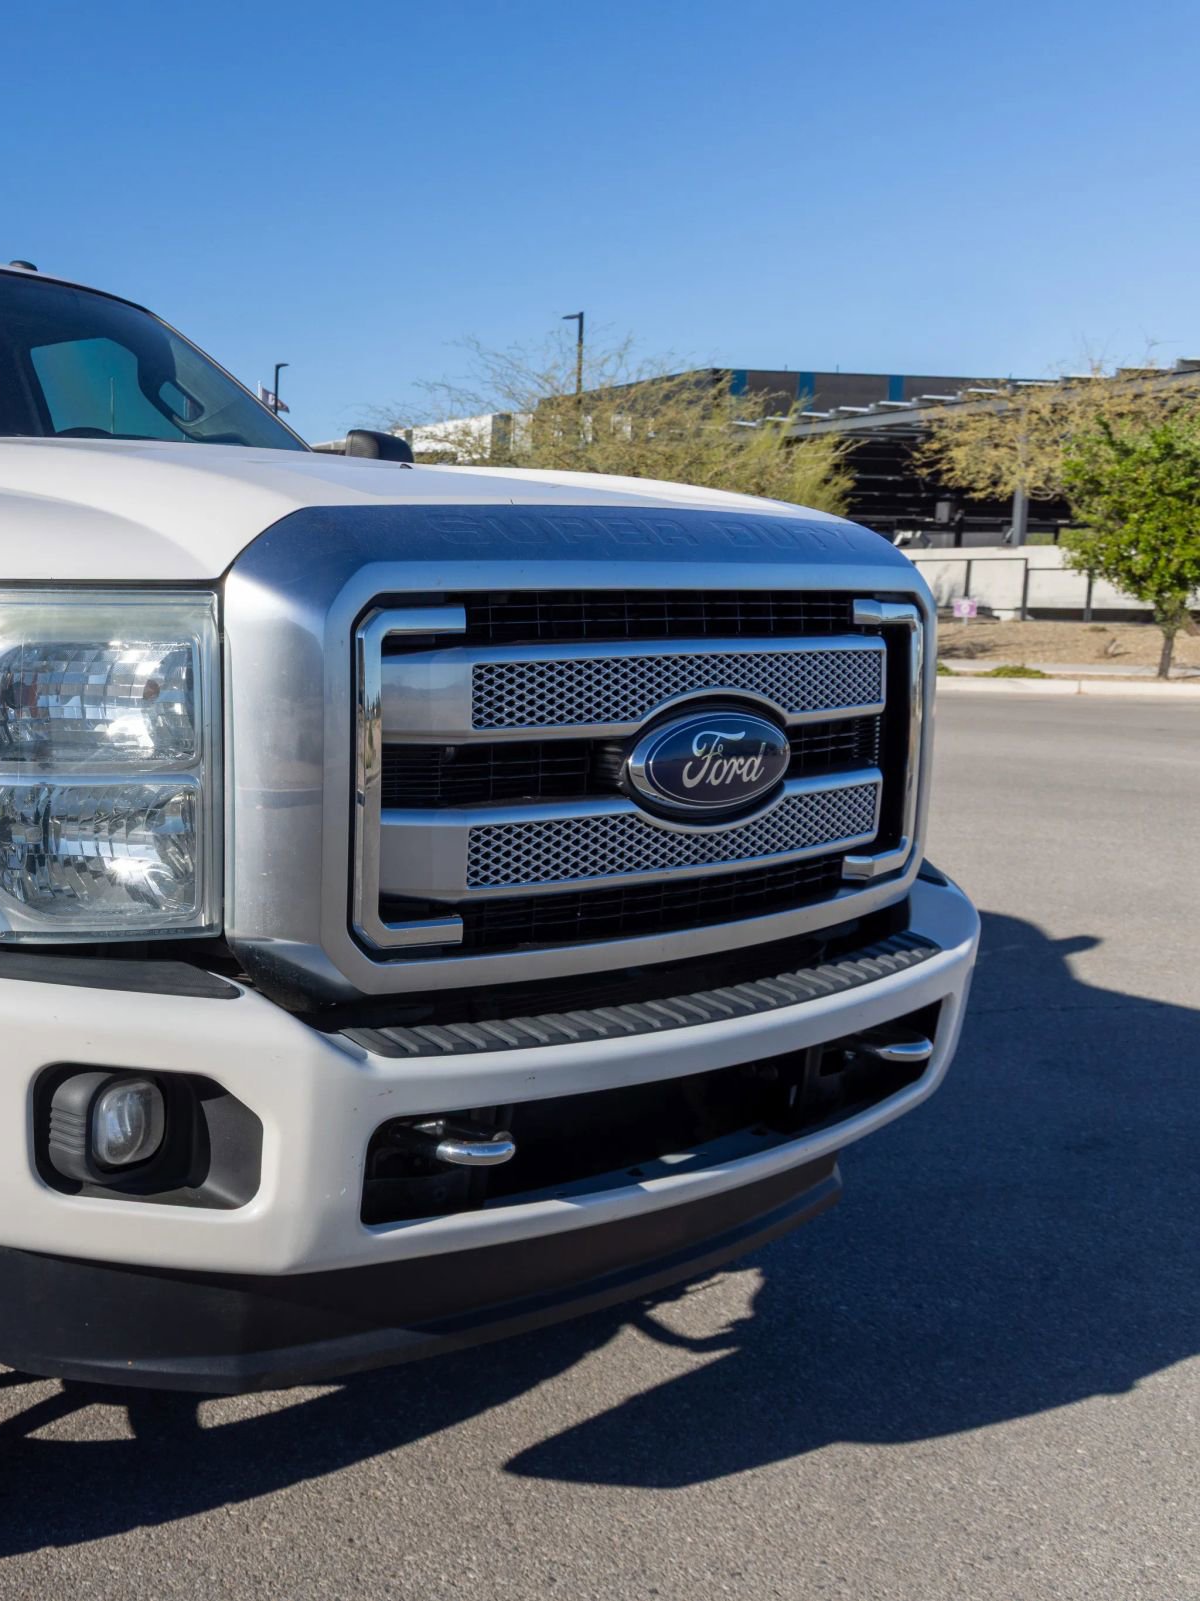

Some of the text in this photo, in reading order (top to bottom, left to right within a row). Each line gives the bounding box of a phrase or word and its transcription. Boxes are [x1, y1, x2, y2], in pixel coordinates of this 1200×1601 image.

[425, 513, 858, 552] SUPER DUTY
[682, 730, 767, 788] Ford
